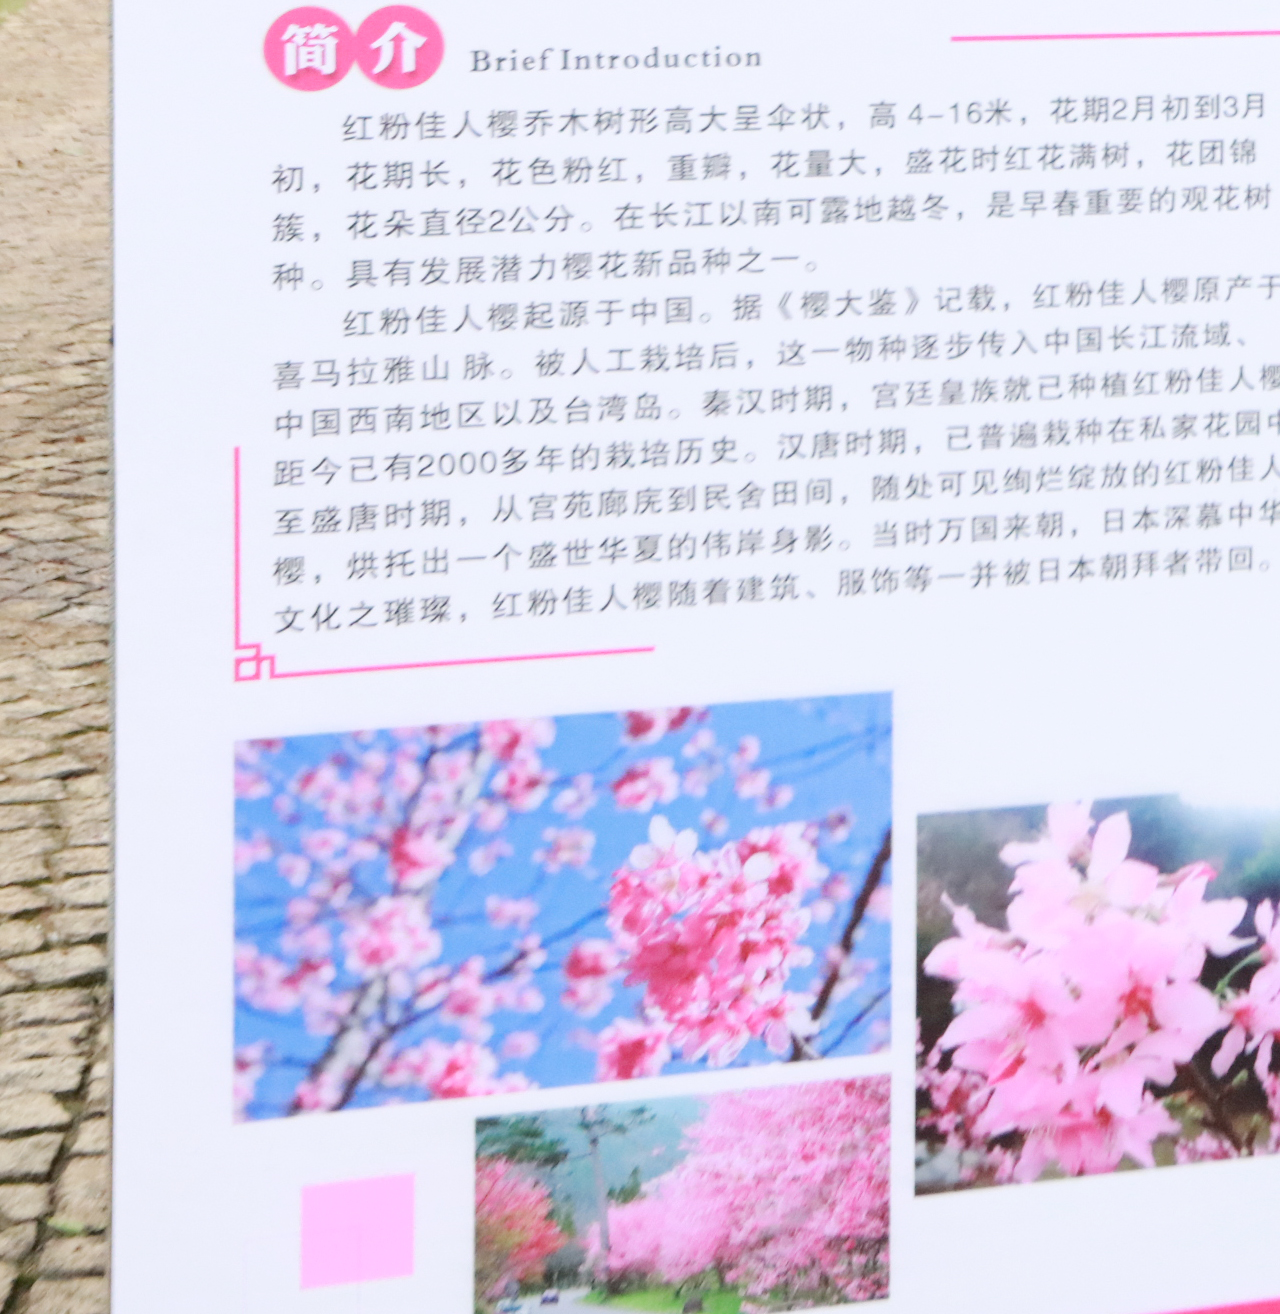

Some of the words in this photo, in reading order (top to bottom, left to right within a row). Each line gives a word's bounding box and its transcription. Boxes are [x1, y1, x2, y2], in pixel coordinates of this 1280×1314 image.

[281, 21, 428, 78] 简介
[470, 47, 555, 73] Brief
[560, 45, 762, 72] Introduction
